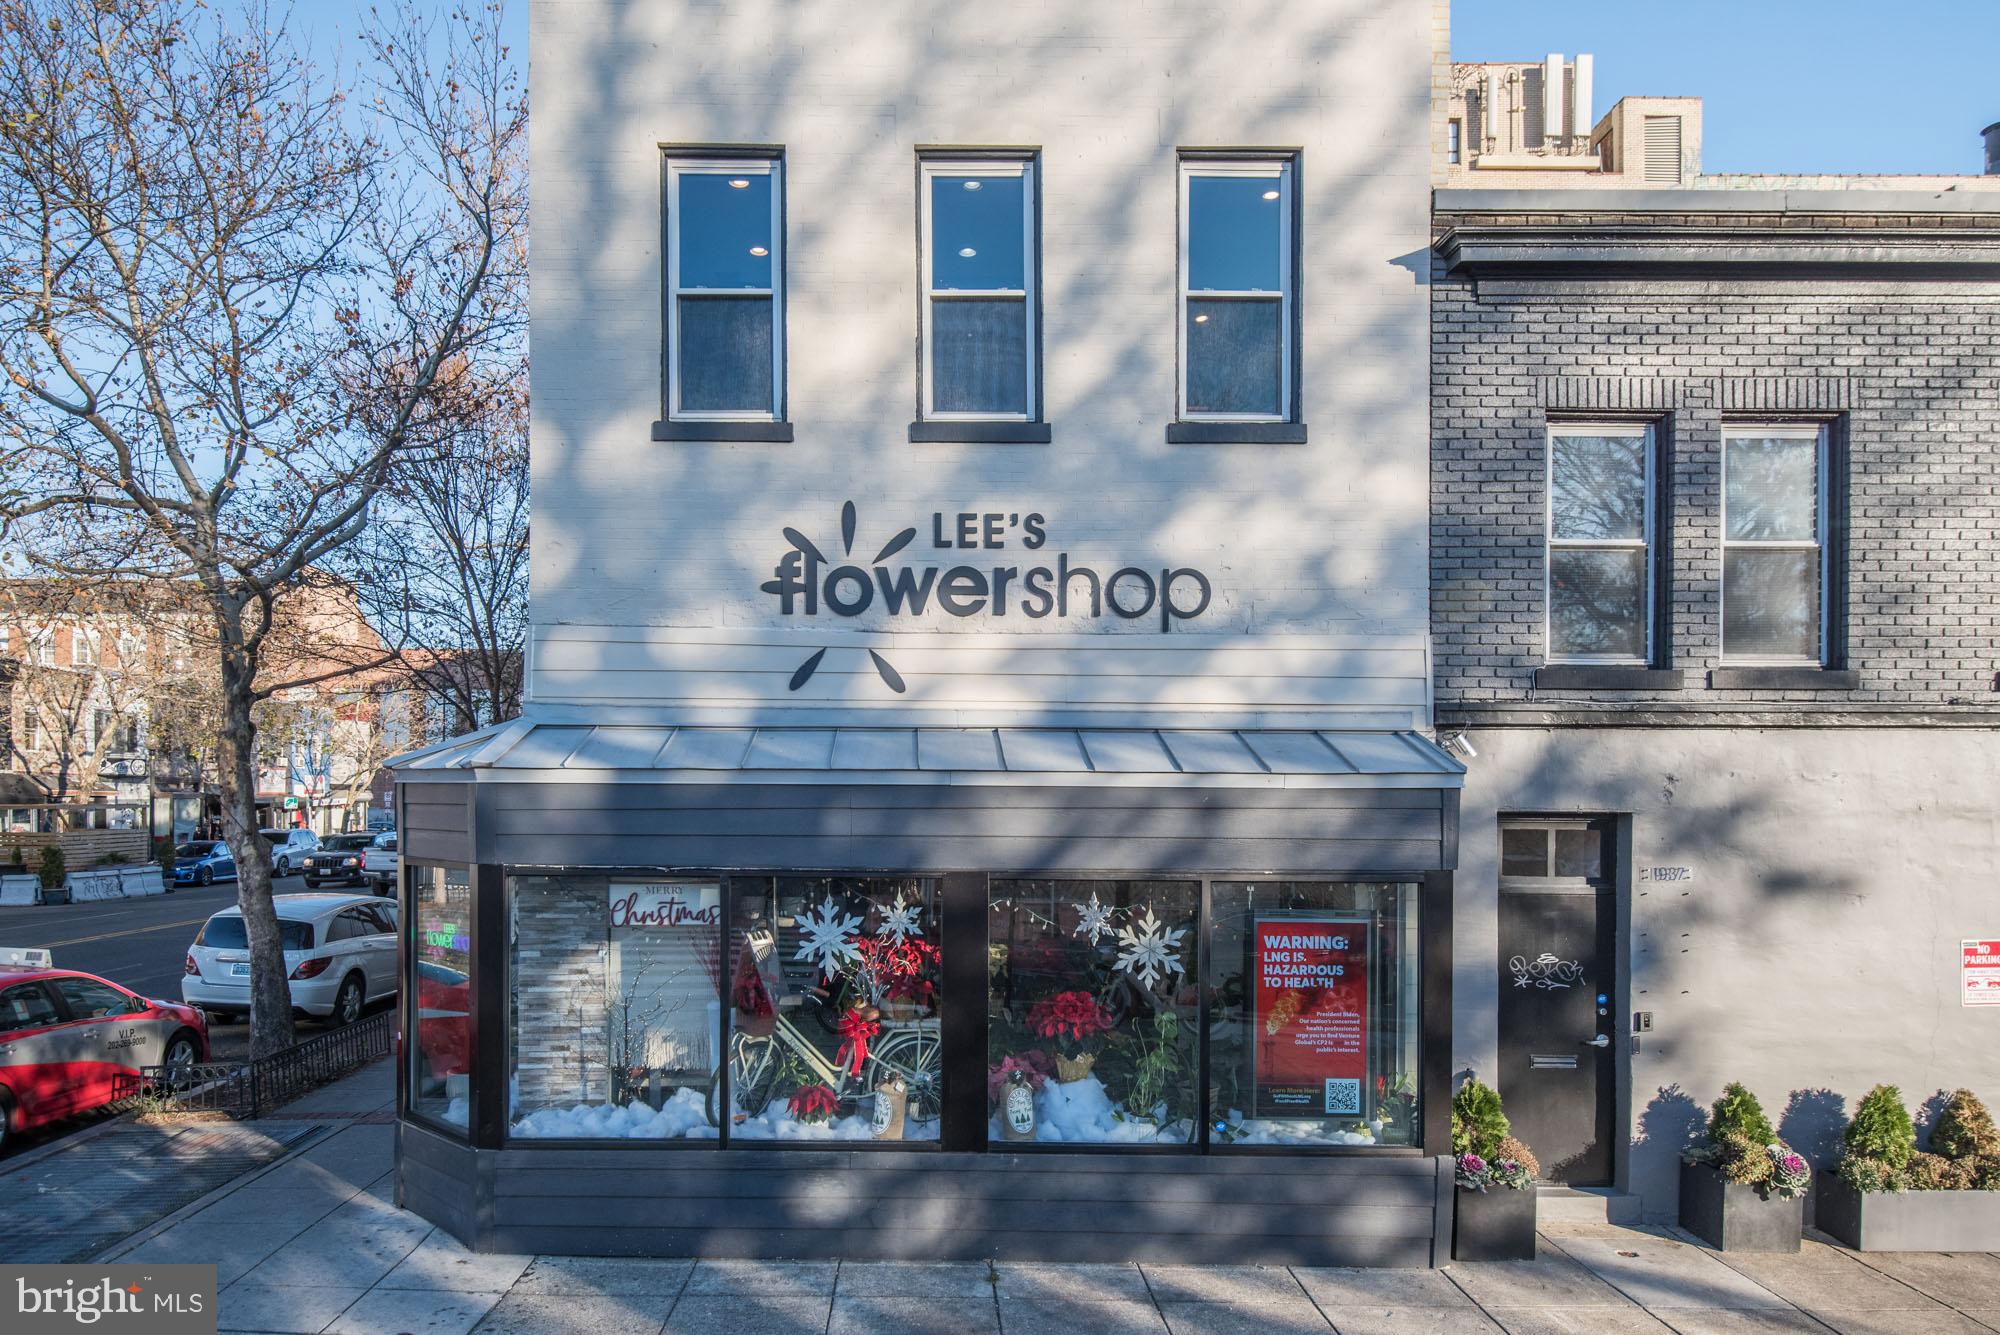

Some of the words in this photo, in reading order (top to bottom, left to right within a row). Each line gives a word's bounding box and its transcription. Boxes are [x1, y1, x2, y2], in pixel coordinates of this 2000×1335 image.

[933, 512, 1046, 549] LEE'S
[775, 550, 1212, 632] flowershop
[645, 886, 684, 896] MERRY
[610, 892, 720, 929] Christmas
[1263, 935, 1349, 950] WARNING:
[1977, 944, 1991, 955] NO
[1263, 952, 1291, 963] LNG
[1293, 952, 1305, 963] IS
[1263, 964, 1344, 976] HAZARDOUS
[1263, 977, 1282, 988] TO
[1284, 977, 1335, 989] HEALTH
[118, 1028, 136, 1039] V.I.P.
